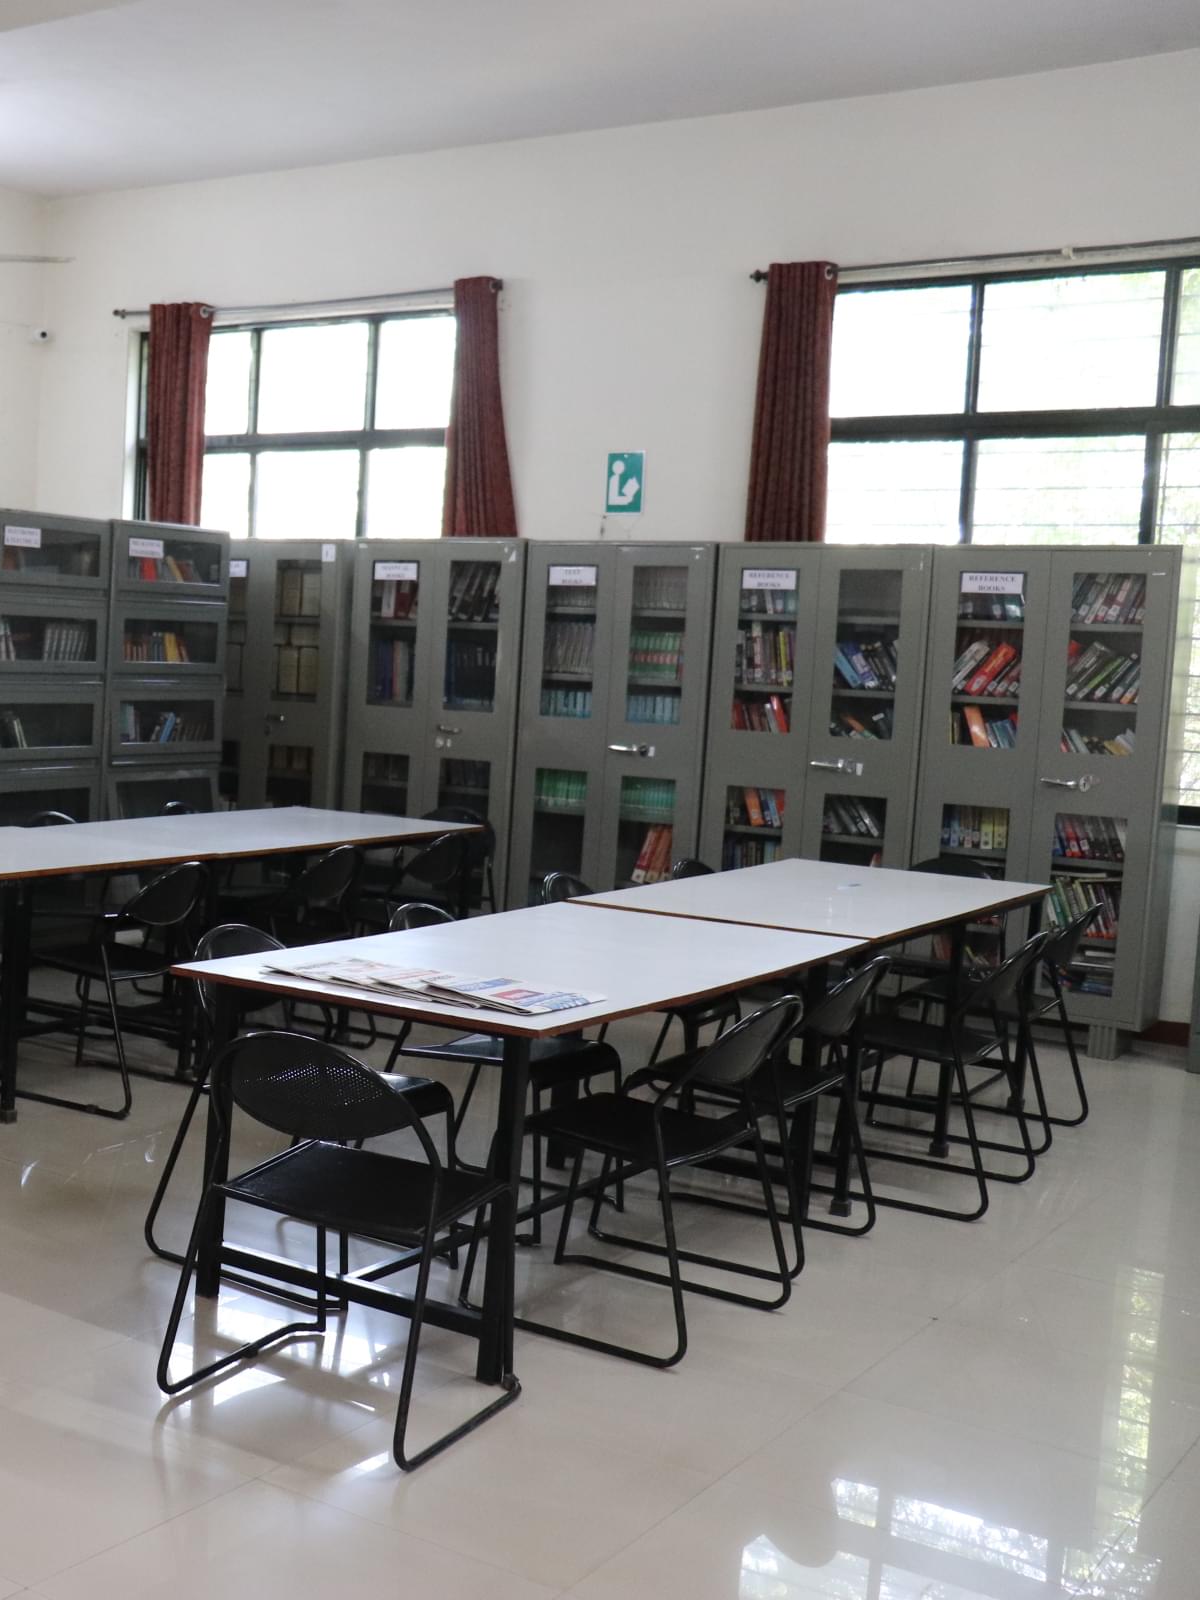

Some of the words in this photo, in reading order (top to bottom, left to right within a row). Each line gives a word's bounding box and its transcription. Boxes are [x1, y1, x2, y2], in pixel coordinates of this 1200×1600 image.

[748, 571, 790, 579] REFERENCE
[968, 575, 1017, 583] REFERENCE
[976, 584, 1006, 592] BOOKS
